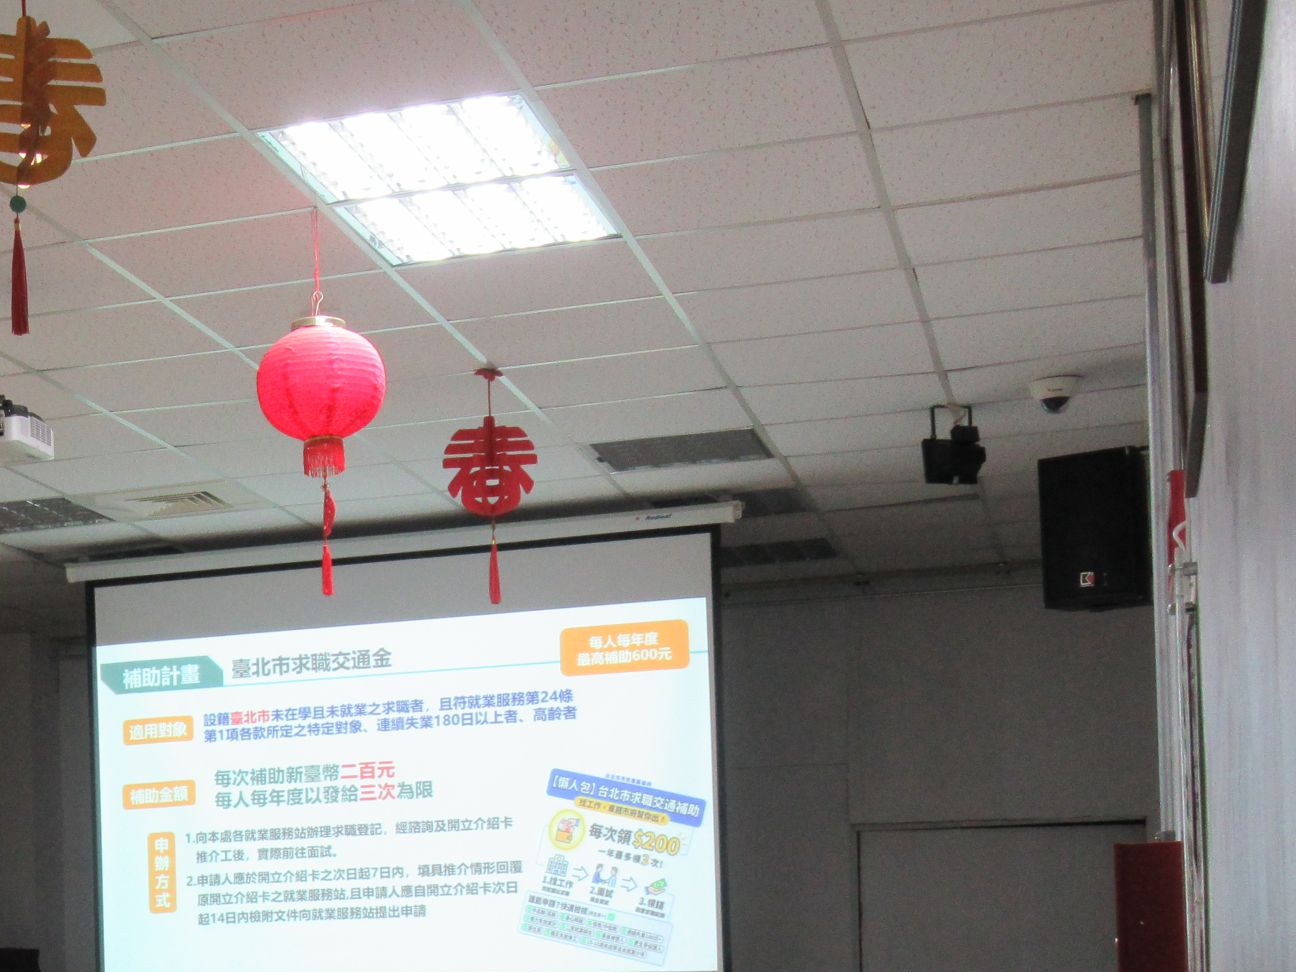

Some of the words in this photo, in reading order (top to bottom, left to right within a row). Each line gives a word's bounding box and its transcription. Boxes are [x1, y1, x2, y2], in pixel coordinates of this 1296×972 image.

[590, 632, 659, 649] 每人每年度
[231, 647, 393, 681] 臺北市求職交通金
[577, 647, 672, 667] 最高補助600元
[123, 664, 201, 690] 補助計畫
[214, 761, 396, 788] 每次補助新臺幣二百元
[214, 781, 434, 809] 每人每年度以發給三次為限
